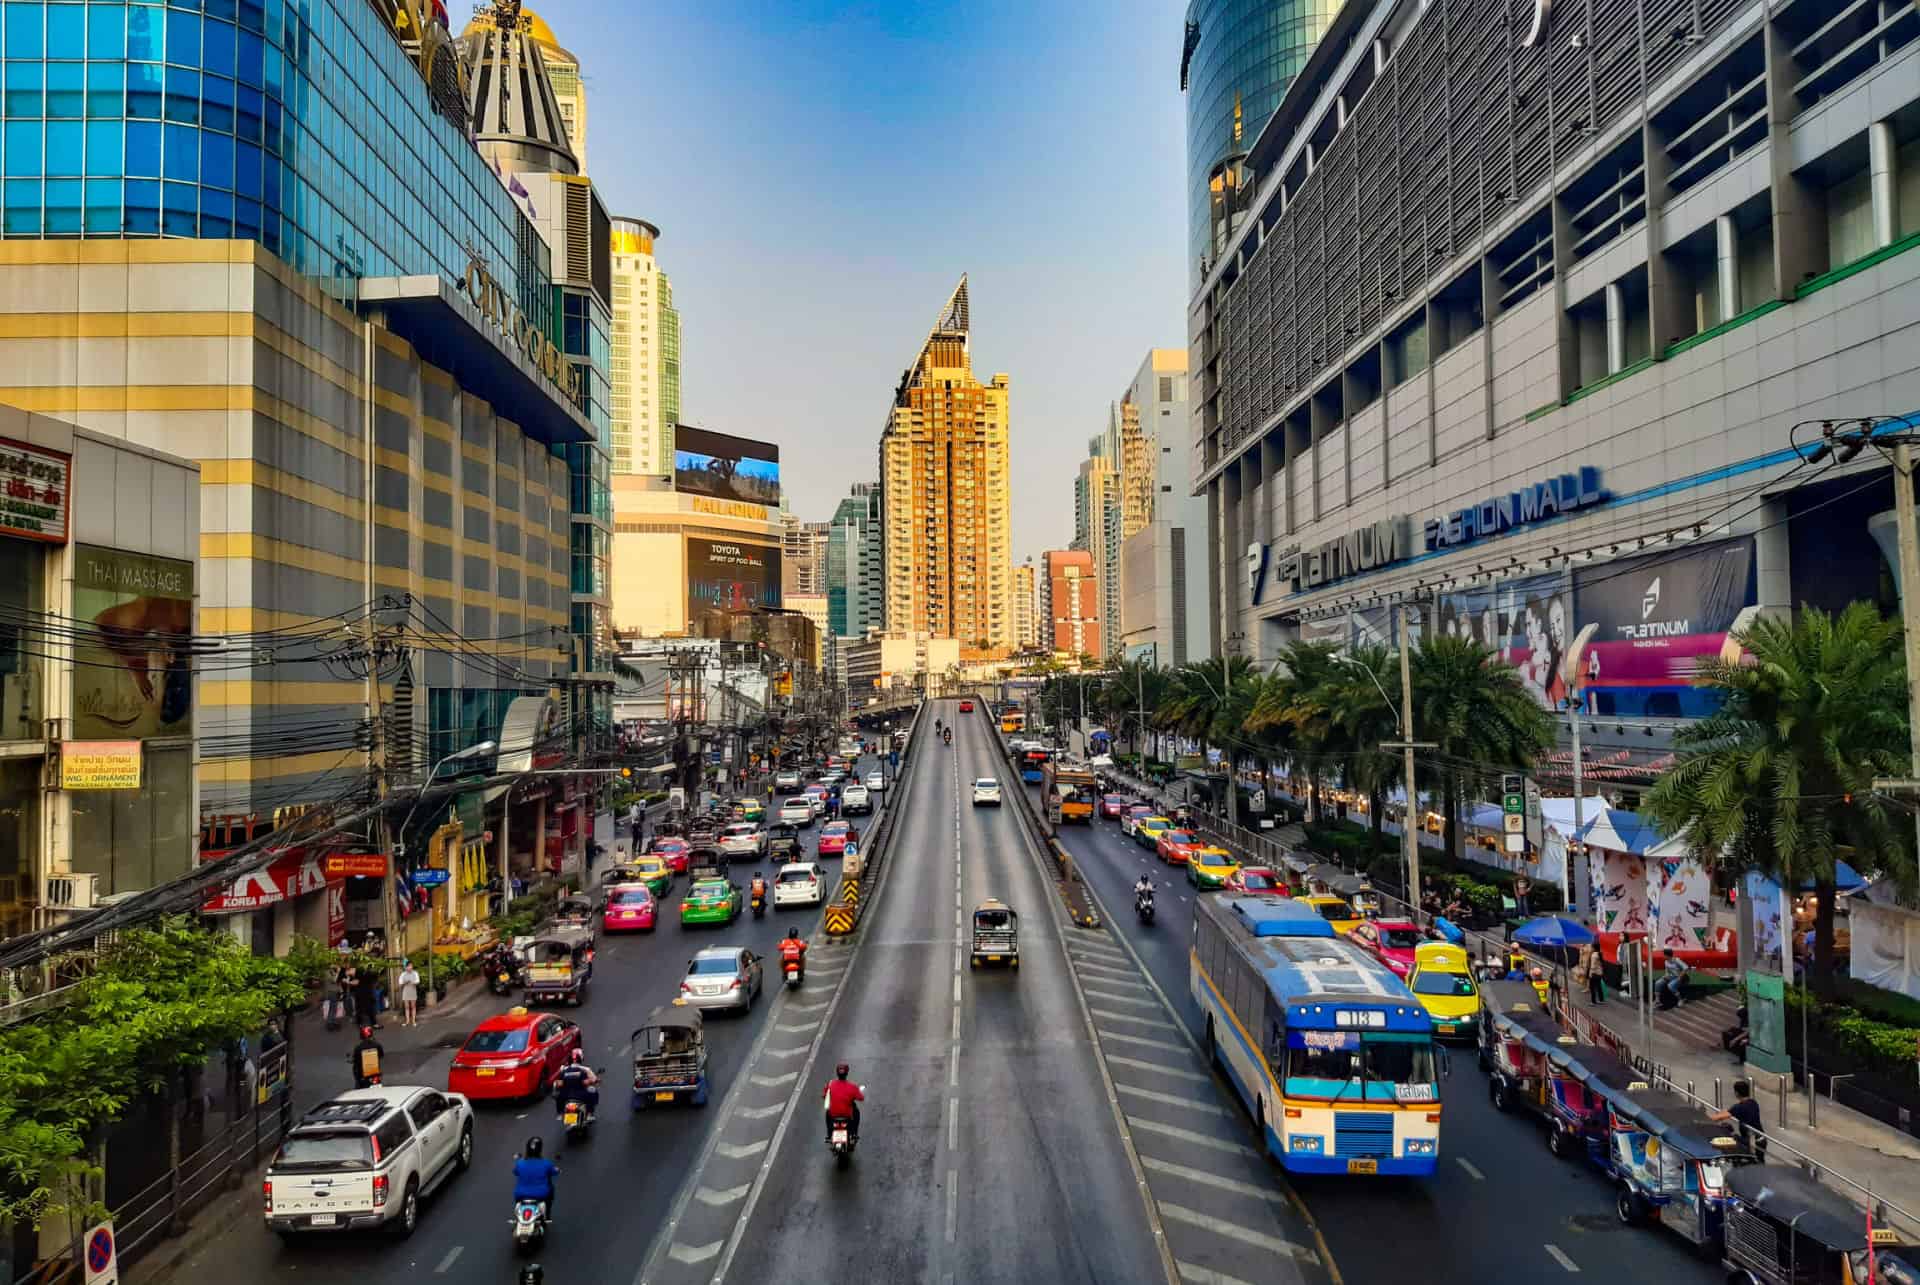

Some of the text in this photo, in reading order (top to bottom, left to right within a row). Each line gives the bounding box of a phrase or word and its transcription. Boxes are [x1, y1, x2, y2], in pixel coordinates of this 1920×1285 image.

[1424, 466, 1604, 551] FASHION MALL
[711, 544, 741, 556] TOYOTA
[87, 561, 183, 592] THAI MASSAGE
[222, 895, 257, 908] KOREA
